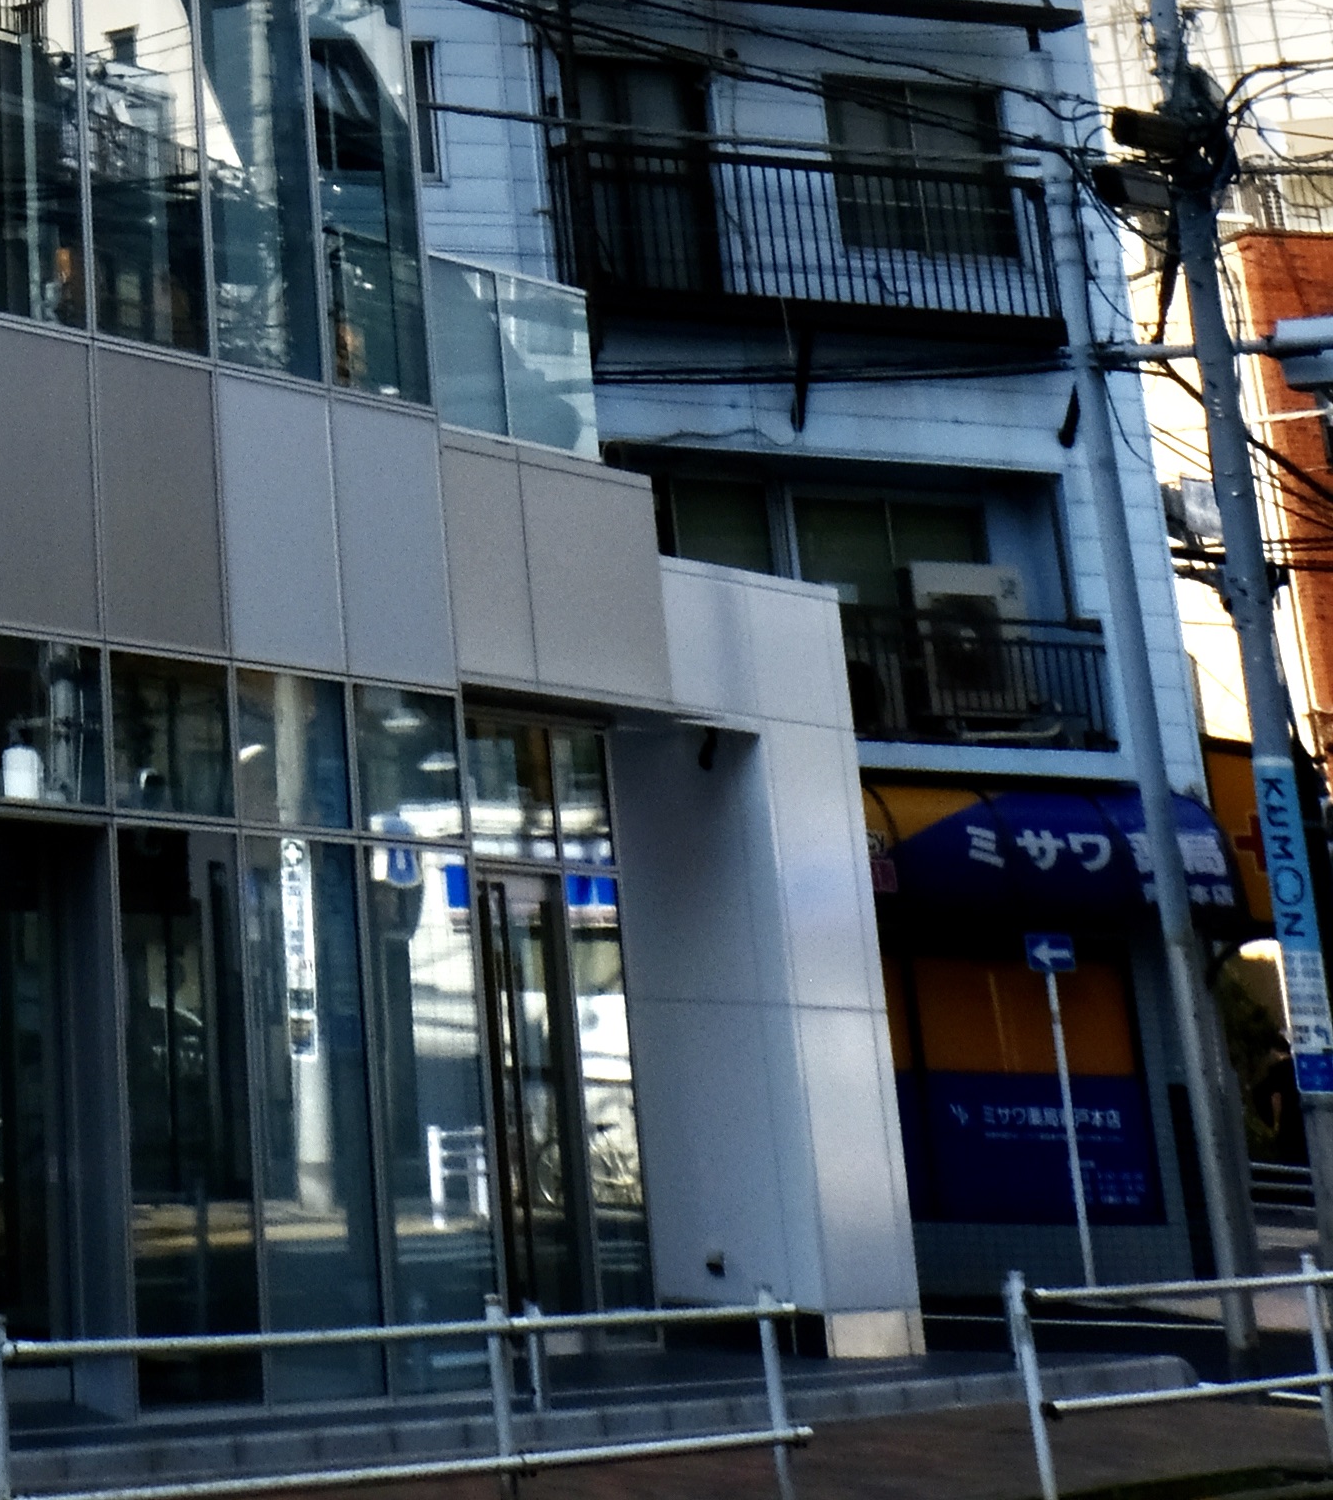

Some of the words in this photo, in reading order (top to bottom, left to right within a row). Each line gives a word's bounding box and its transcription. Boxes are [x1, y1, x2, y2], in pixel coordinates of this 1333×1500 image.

[1261, 777, 1306, 938] KUMON
[983, 1104, 1122, 1129] ミサワ薬局戸本店
